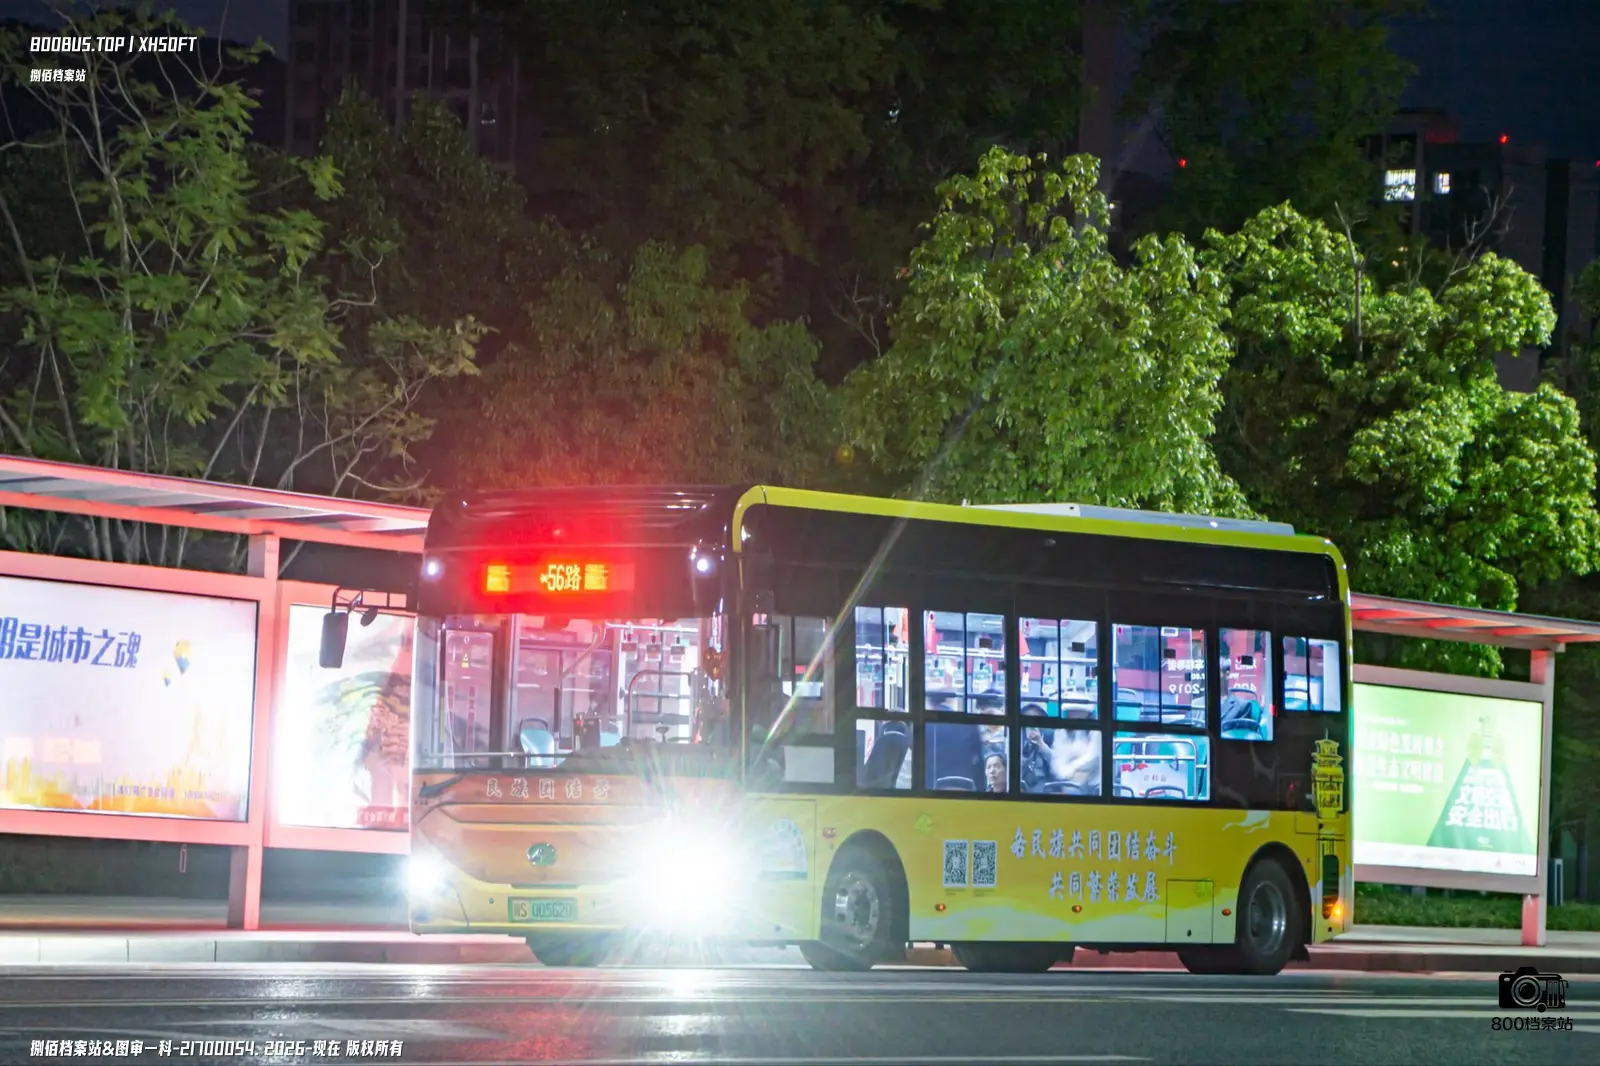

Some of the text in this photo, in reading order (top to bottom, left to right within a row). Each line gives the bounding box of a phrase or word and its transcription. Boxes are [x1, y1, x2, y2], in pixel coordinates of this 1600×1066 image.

[0, 616, 142, 669] 明是城市之魂
[486, 778, 611, 799] 民族团结号
[1009, 825, 1178, 866] 各民族共同团结奋斗
[1048, 869, 1161, 902] 共同繁荣发展
